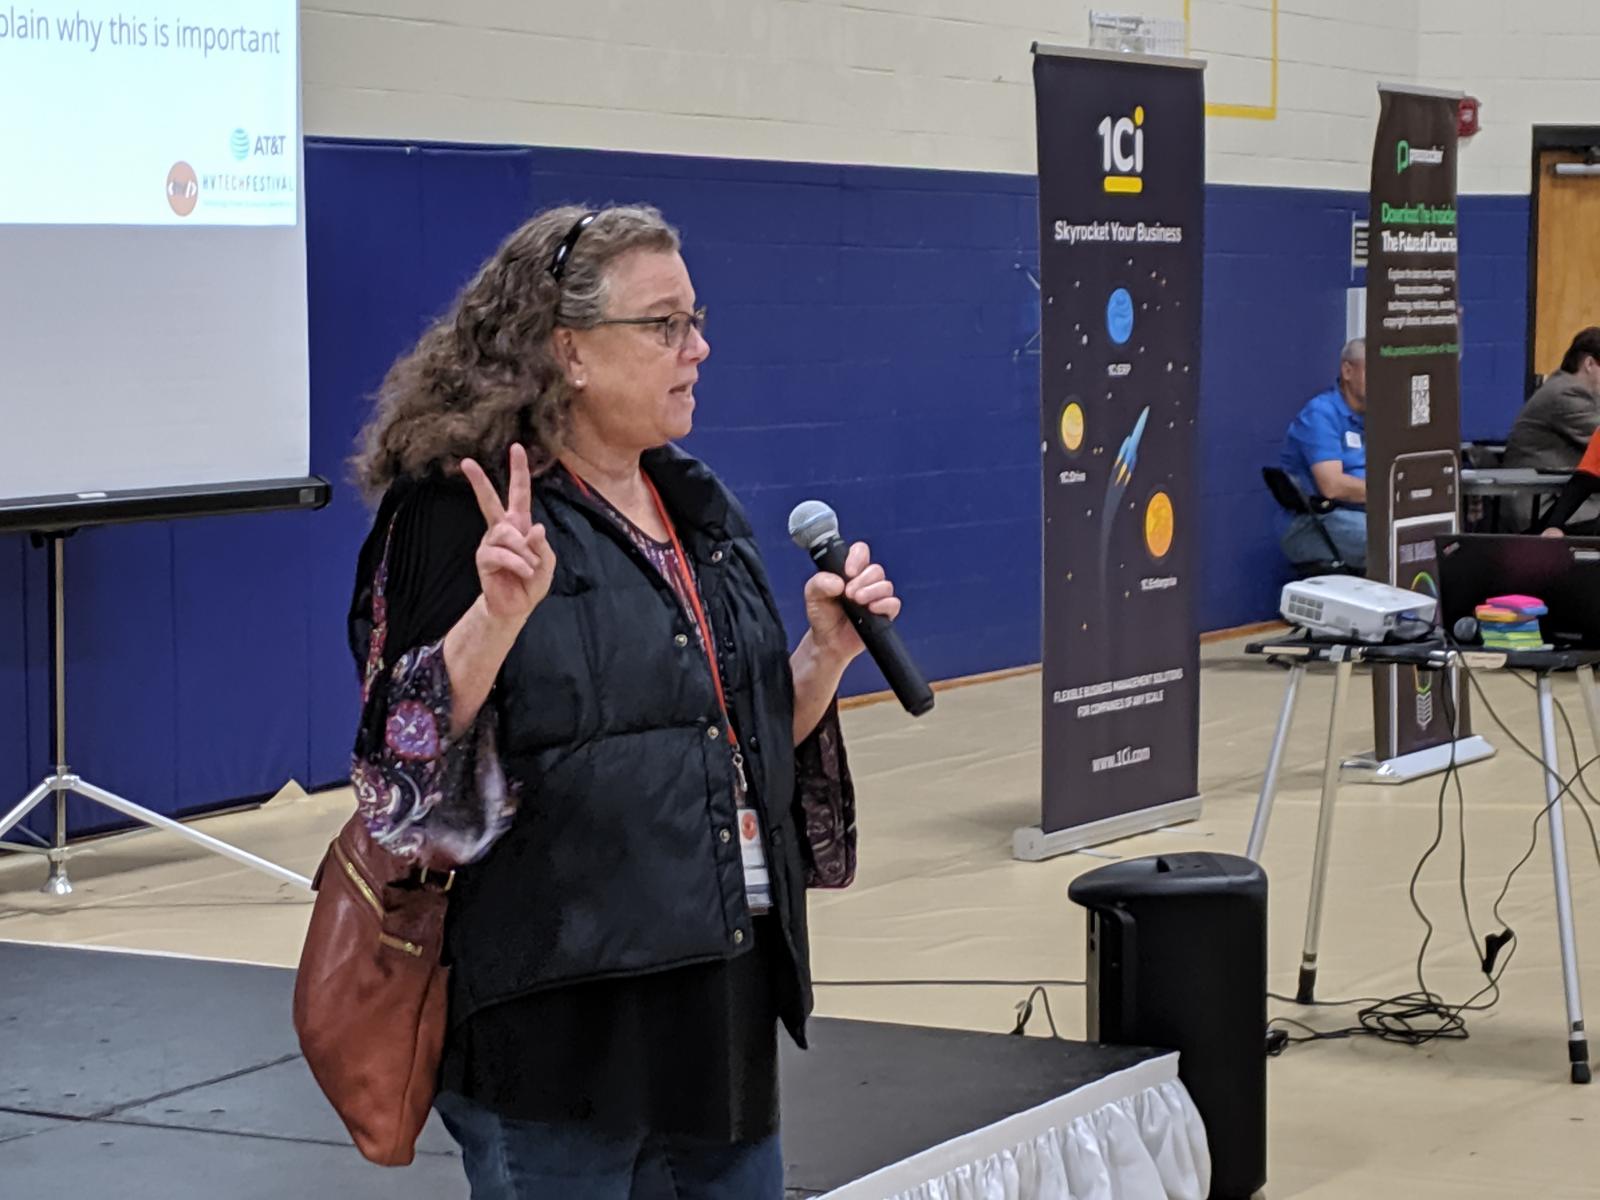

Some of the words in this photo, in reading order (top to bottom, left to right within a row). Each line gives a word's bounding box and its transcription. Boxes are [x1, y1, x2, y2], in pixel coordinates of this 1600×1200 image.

[56, 9, 103, 52] why
[109, 13, 147, 47] this
[154, 17, 169, 48] is
[176, 18, 281, 58] important
[254, 135, 286, 156] AT&T
[1097, 105, 1145, 173] 1Ci
[1054, 220, 1110, 246] Skyrocket
[1111, 222, 1136, 242] Your
[1137, 222, 1183, 243] Business
[1381, 230, 1398, 252] The
